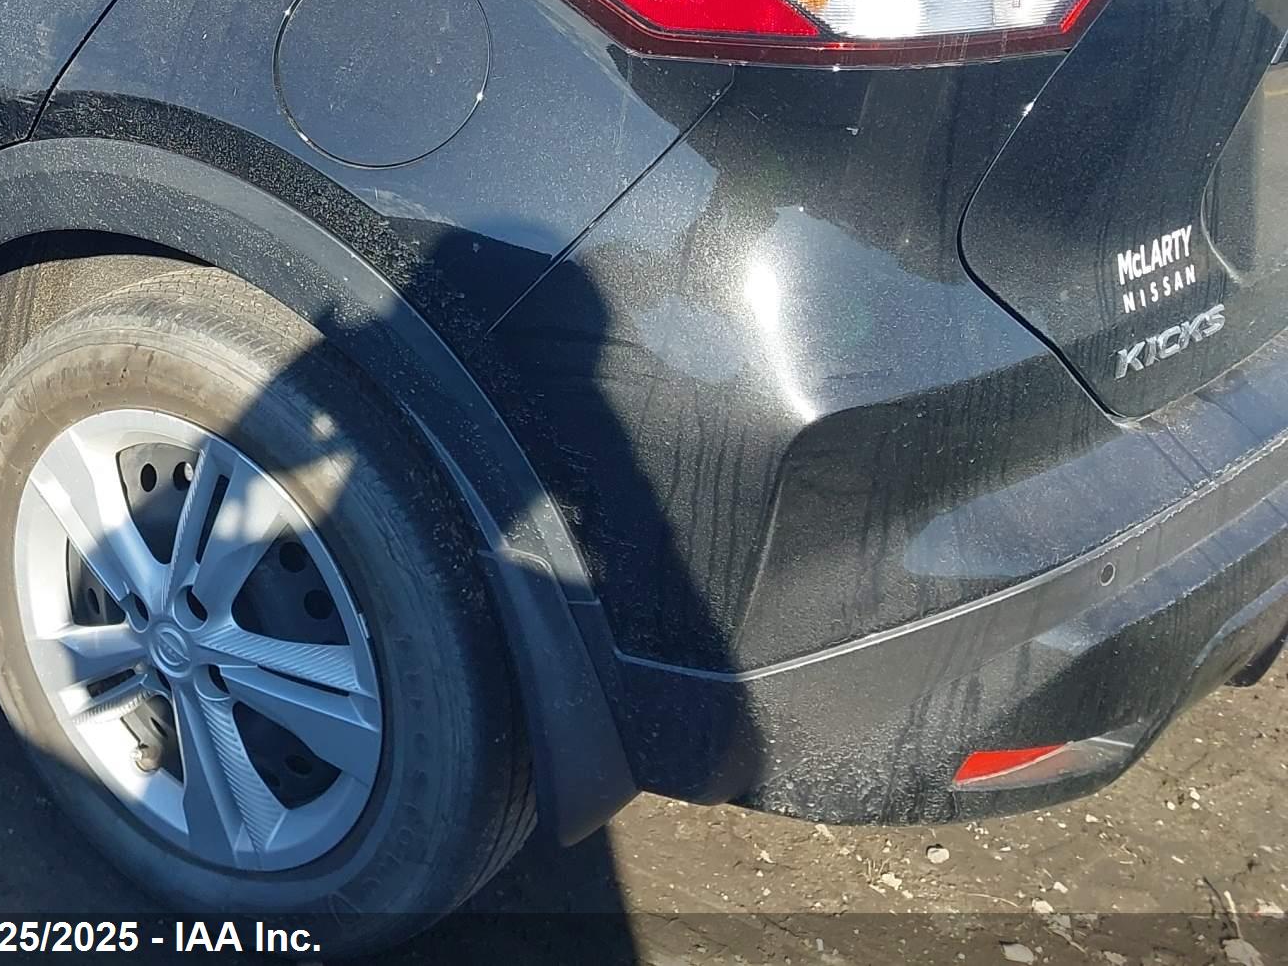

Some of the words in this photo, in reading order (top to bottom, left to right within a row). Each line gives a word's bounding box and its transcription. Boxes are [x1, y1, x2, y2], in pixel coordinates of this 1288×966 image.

[1117, 224, 1192, 286] McLARTY
[1122, 263, 1196, 314] NISSAN
[1114, 303, 1226, 379] KICKS
